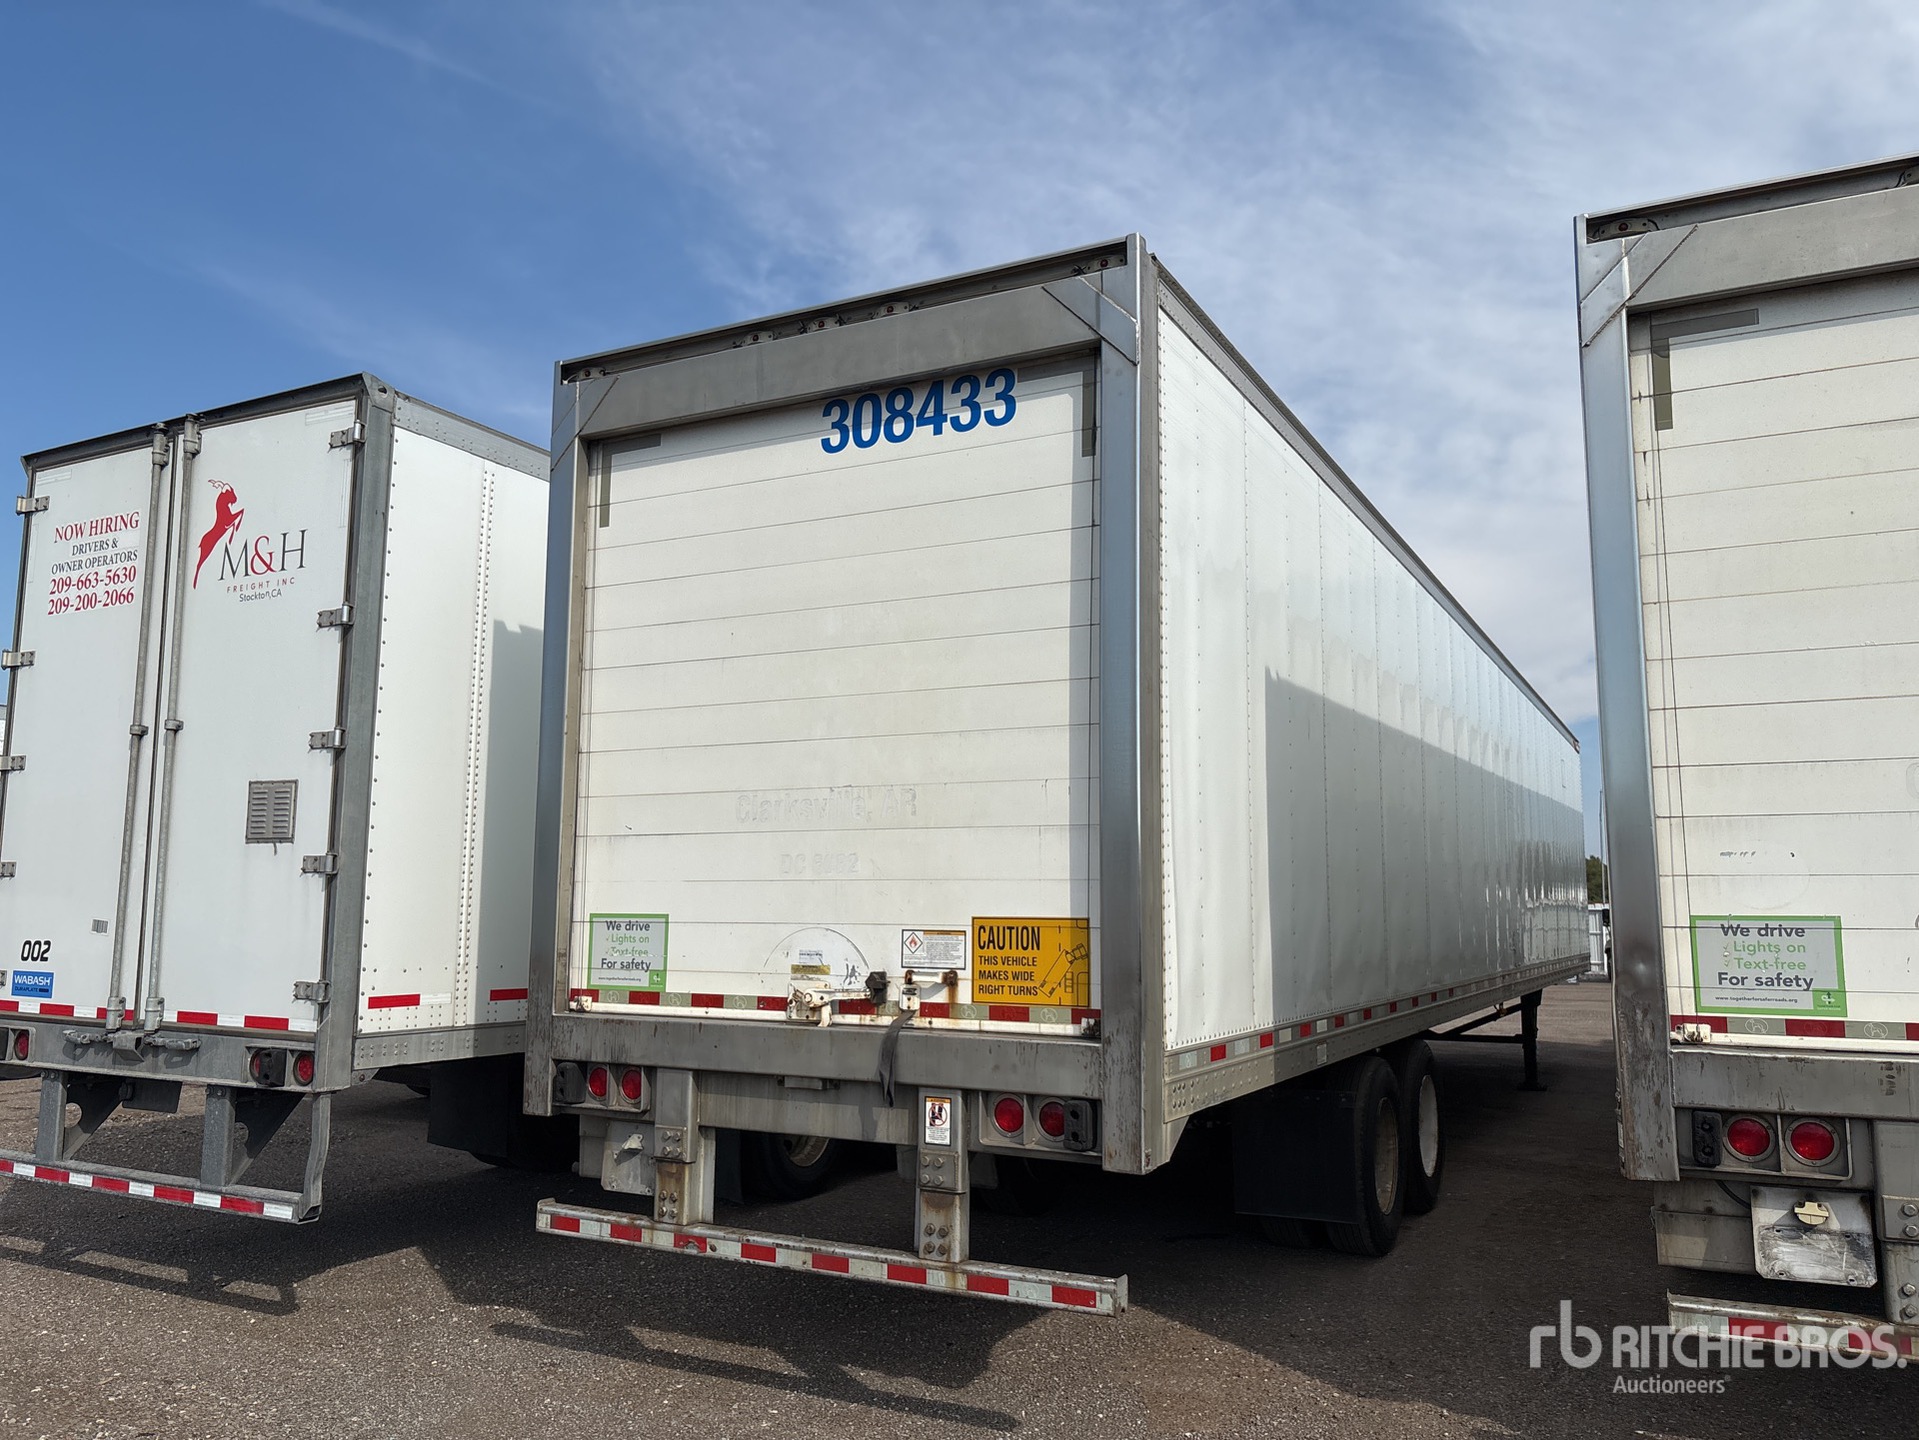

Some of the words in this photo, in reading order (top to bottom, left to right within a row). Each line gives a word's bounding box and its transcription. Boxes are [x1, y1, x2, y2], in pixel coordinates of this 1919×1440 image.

[821, 368, 1017, 454] 308433
[54, 522, 86, 543] NOW
[88, 511, 140, 537] HIRING
[72, 539, 110, 556] DRIVERS
[111, 537, 118, 549] &
[51, 560, 83, 575] OWNER
[84, 549, 138, 569] OPERATORS
[218, 529, 308, 581] M&H
[49, 565, 137, 595] 209-663-5630
[226, 580, 270, 593] FREIGHT
[277, 577, 295, 586] INC
[47, 586, 134, 615] 209-200-2066
[605, 920, 621, 931] We
[625, 920, 650, 931] drive
[1720, 923, 1750, 937] We
[1757, 923, 1806, 937] drive
[611, 934, 636, 945] Lights
[978, 925, 1040, 951] CAUTION
[20, 940, 51, 961] 002
[1733, 940, 1781, 955] Lights
[1786, 943, 1806, 953] on
[601, 958, 617, 969] For
[620, 958, 651, 972] safety
[978, 955, 998, 966] THIS
[1000, 956, 1037, 967] VEHICLE
[1733, 957, 1807, 970] Text-free
[14, 974, 51, 986] WABASH
[978, 970, 1009, 981] MAKES
[1011, 971, 1035, 981] WIDE
[1717, 972, 1748, 986] For
[1754, 972, 1814, 991] safety
[978, 984, 1006, 995] RIGHT
[1008, 985, 1038, 996] TURNS
